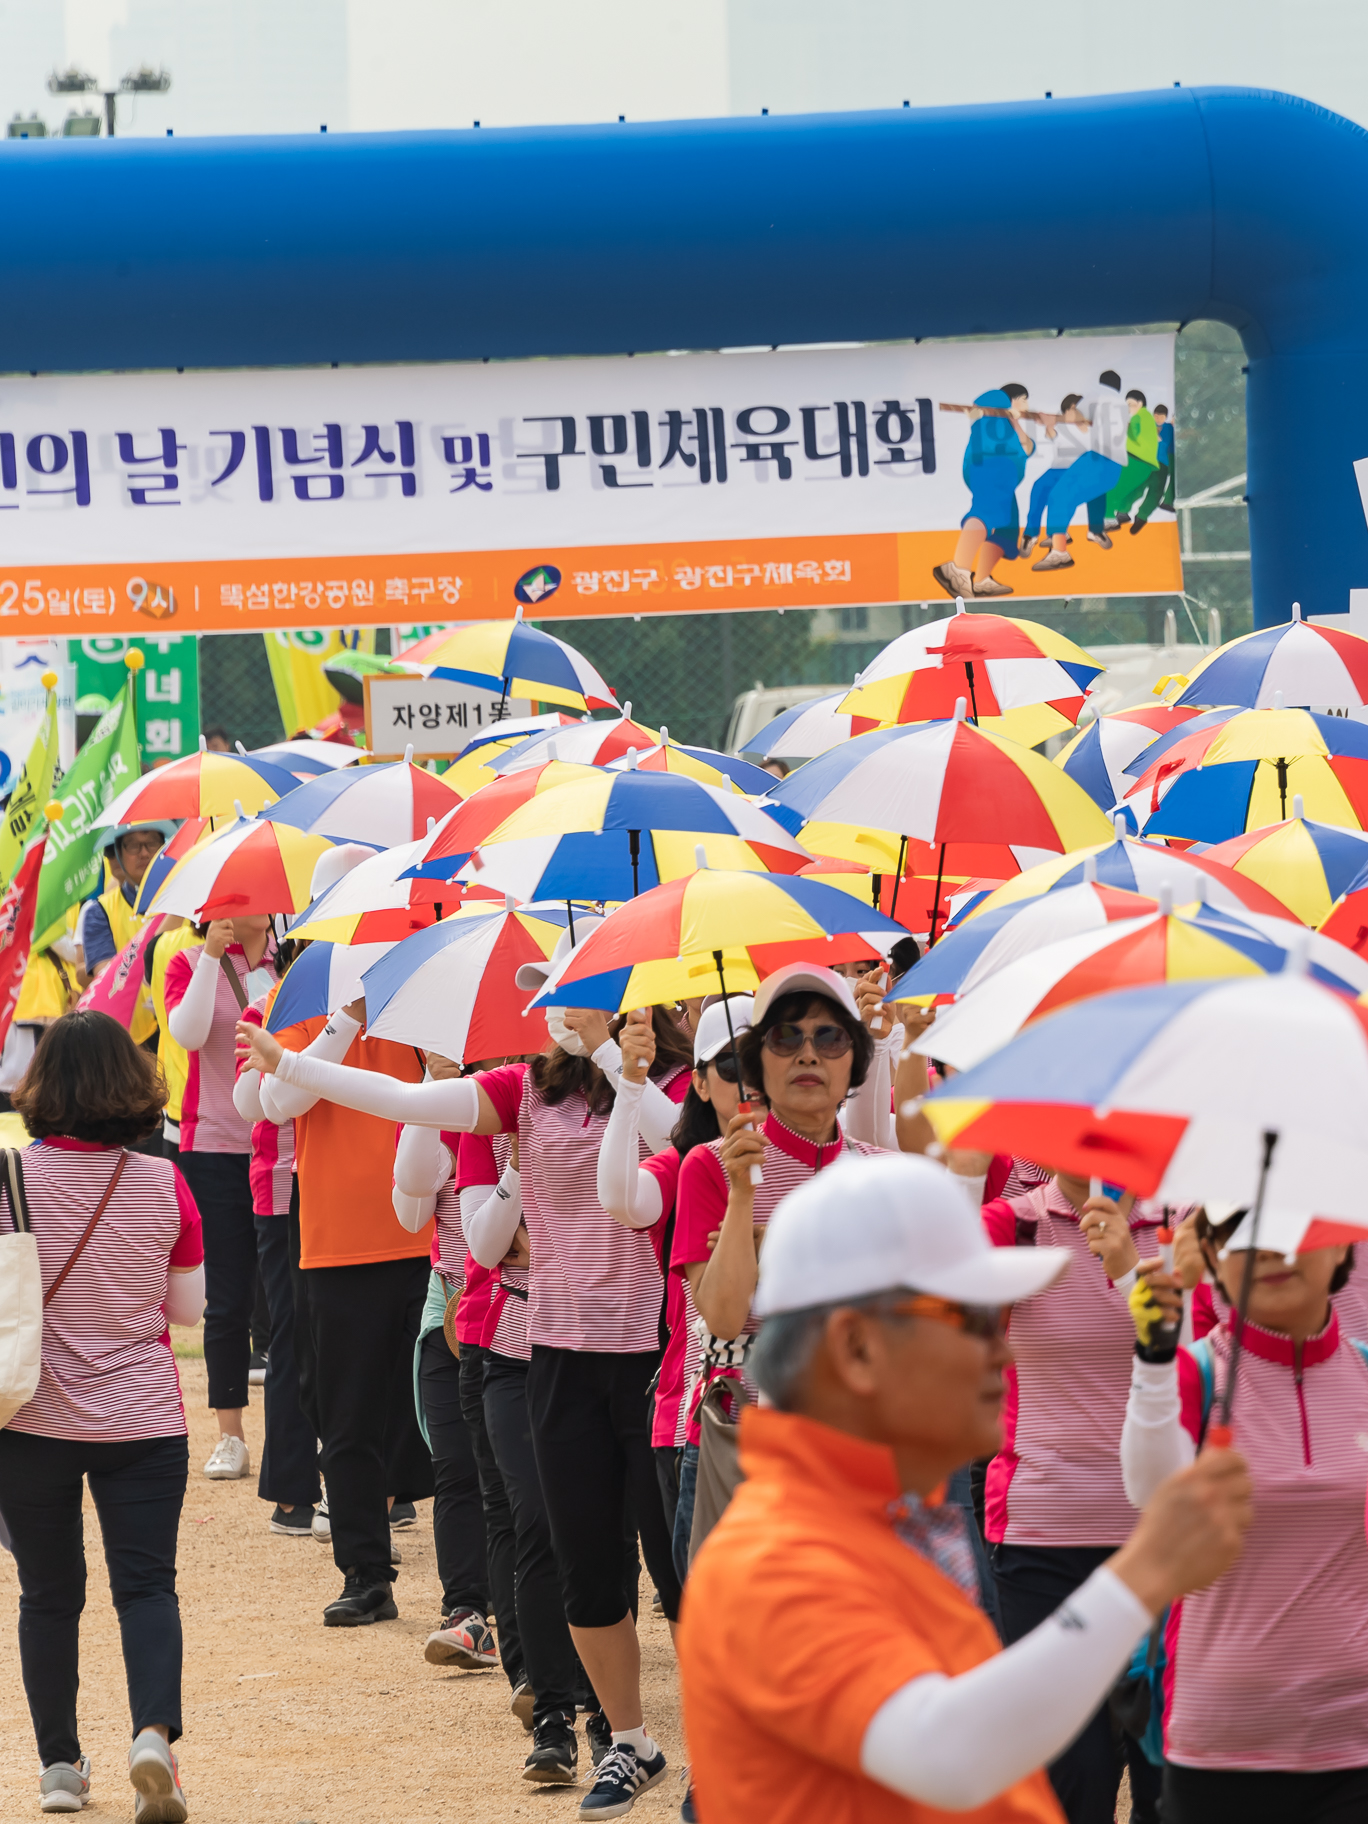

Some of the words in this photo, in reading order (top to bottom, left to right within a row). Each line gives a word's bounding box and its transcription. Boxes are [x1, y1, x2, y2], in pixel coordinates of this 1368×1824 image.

[114, 427, 187, 505] 날
[208, 420, 418, 503] 기념식
[441, 432, 494, 494] 및
[516, 397, 938, 491] 구민체육대회
[126, 576, 174, 614] 9시
[220, 579, 374, 611] 뚝섬한강공원
[385, 576, 463, 605] 축구장
[571, 568, 659, 595] 광진구
[673, 559, 852, 590] 광진구체육회
[392, 700, 512, 730] 자양제1동
